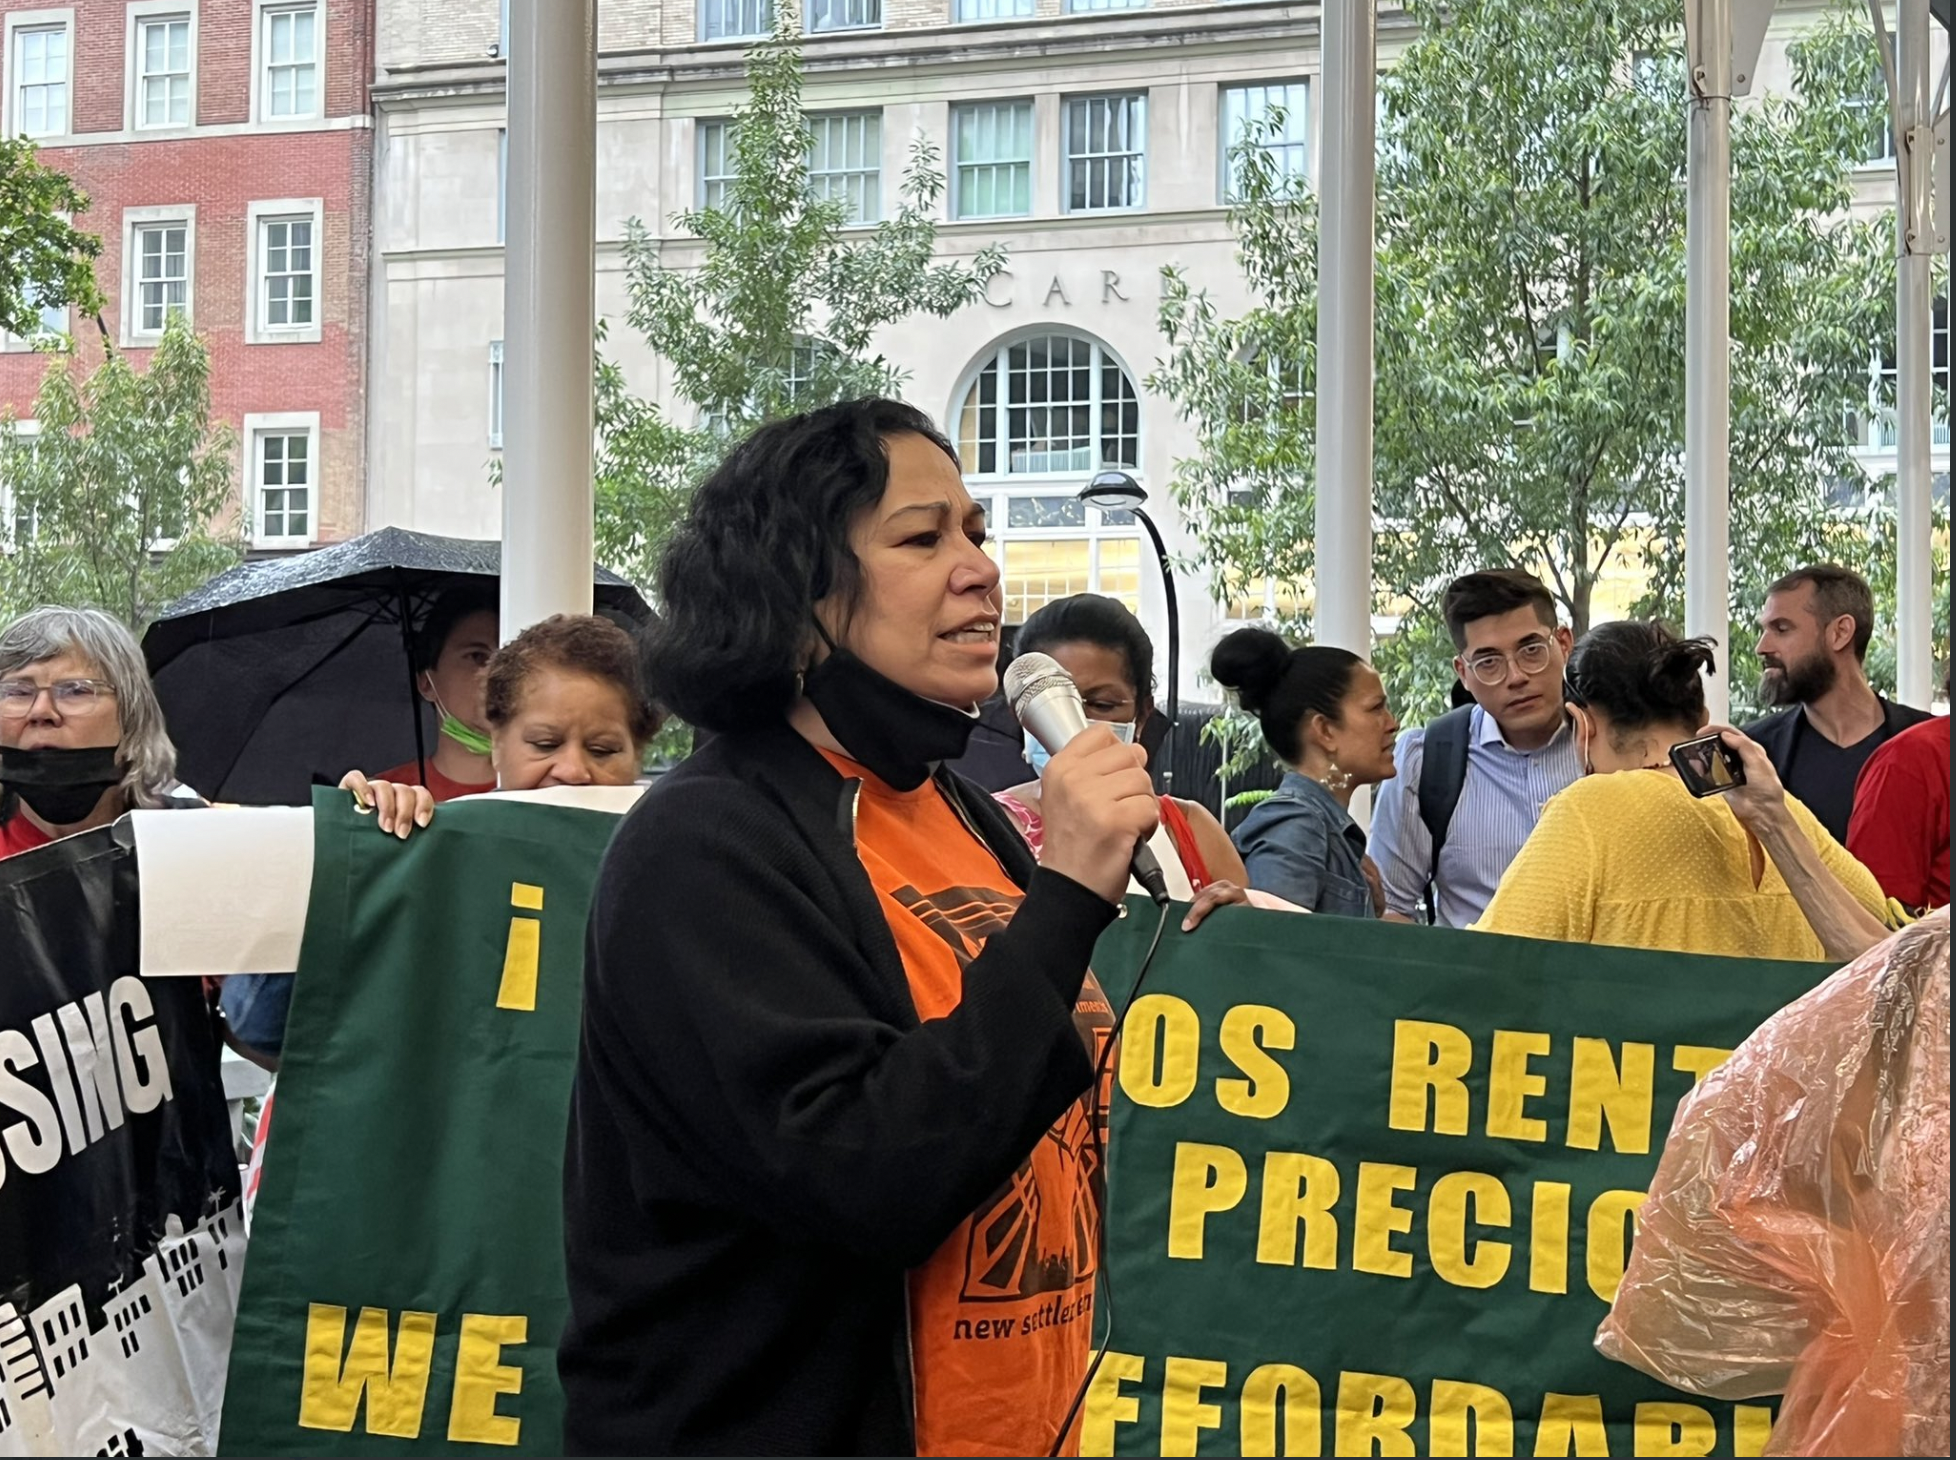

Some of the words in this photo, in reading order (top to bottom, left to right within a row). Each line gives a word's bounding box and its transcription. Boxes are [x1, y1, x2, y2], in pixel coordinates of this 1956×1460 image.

[0, 975, 173, 1189] SING
[1119, 994, 1295, 1119] OS
[298, 1302, 527, 1446] WE
[954, 1318, 1016, 1340] new
